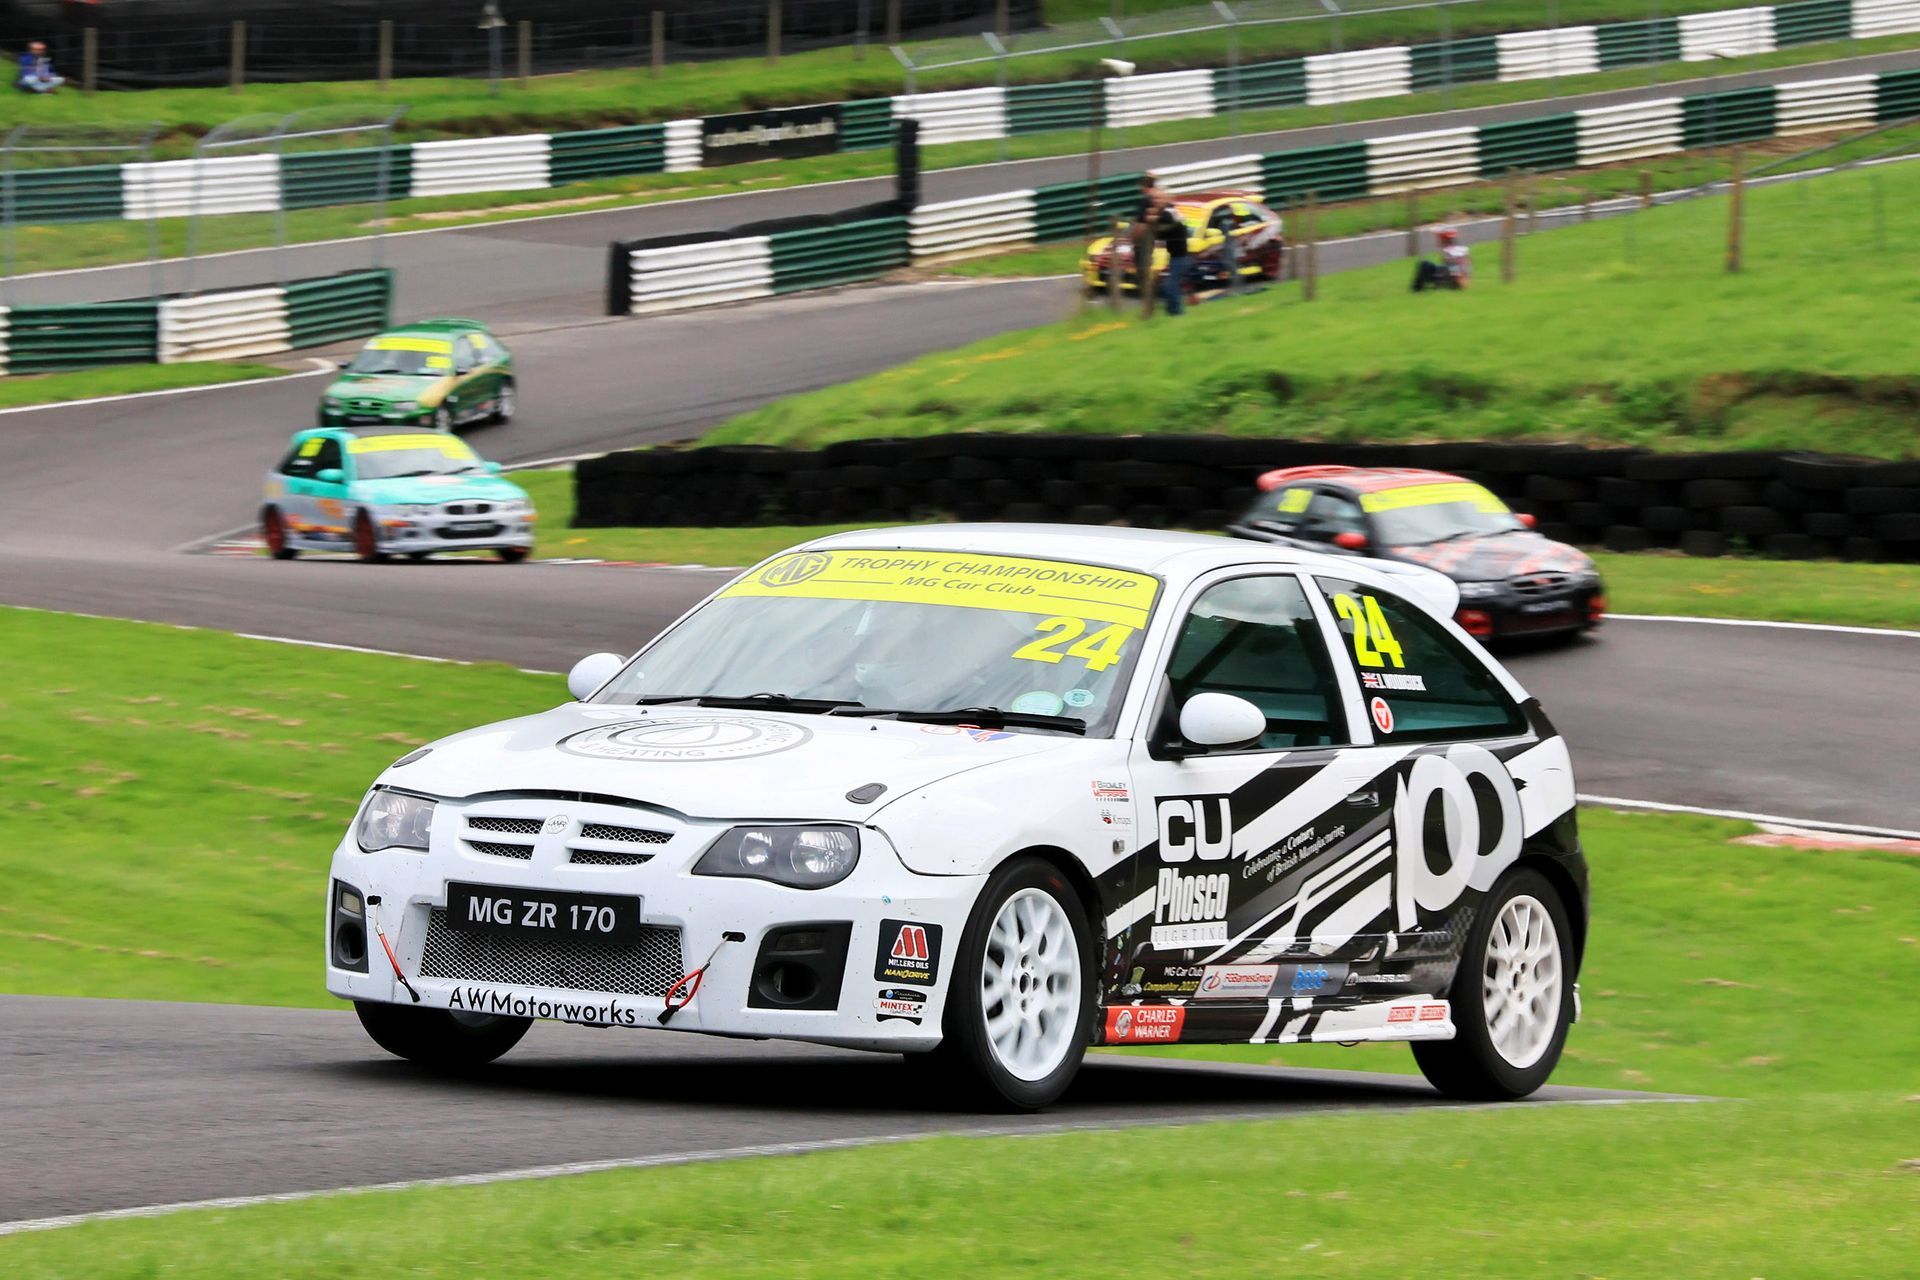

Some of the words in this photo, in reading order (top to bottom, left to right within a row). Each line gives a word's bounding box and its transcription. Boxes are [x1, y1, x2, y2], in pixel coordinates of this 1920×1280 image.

[769, 553, 828, 586] MG
[840, 557, 940, 572] TROPHY
[942, 561, 1138, 592] CHAMPIONSHIP
[902, 577, 940, 589] MG
[943, 579, 983, 592] Car
[986, 582, 1036, 596] Club
[1012, 616, 1135, 673] 24
[1334, 593, 1405, 668] 24
[1158, 798, 1231, 863] CU
[1287, 826, 1315, 850] Century
[1155, 867, 1230, 924] Phosco
[467, 895, 512, 925] MG
[521, 900, 557, 929] ZR
[570, 904, 616, 933] 170
[888, 958, 915, 968] MILLERS
[1164, 967, 1175, 976] MG
[1175, 967, 1188, 976] Car
[448, 986, 636, 1024] AWMotorworks
[880, 1001, 913, 1011] MINTEX
[1136, 1009, 1177, 1023] CHARLES
[1134, 1025, 1171, 1038] WARNER
